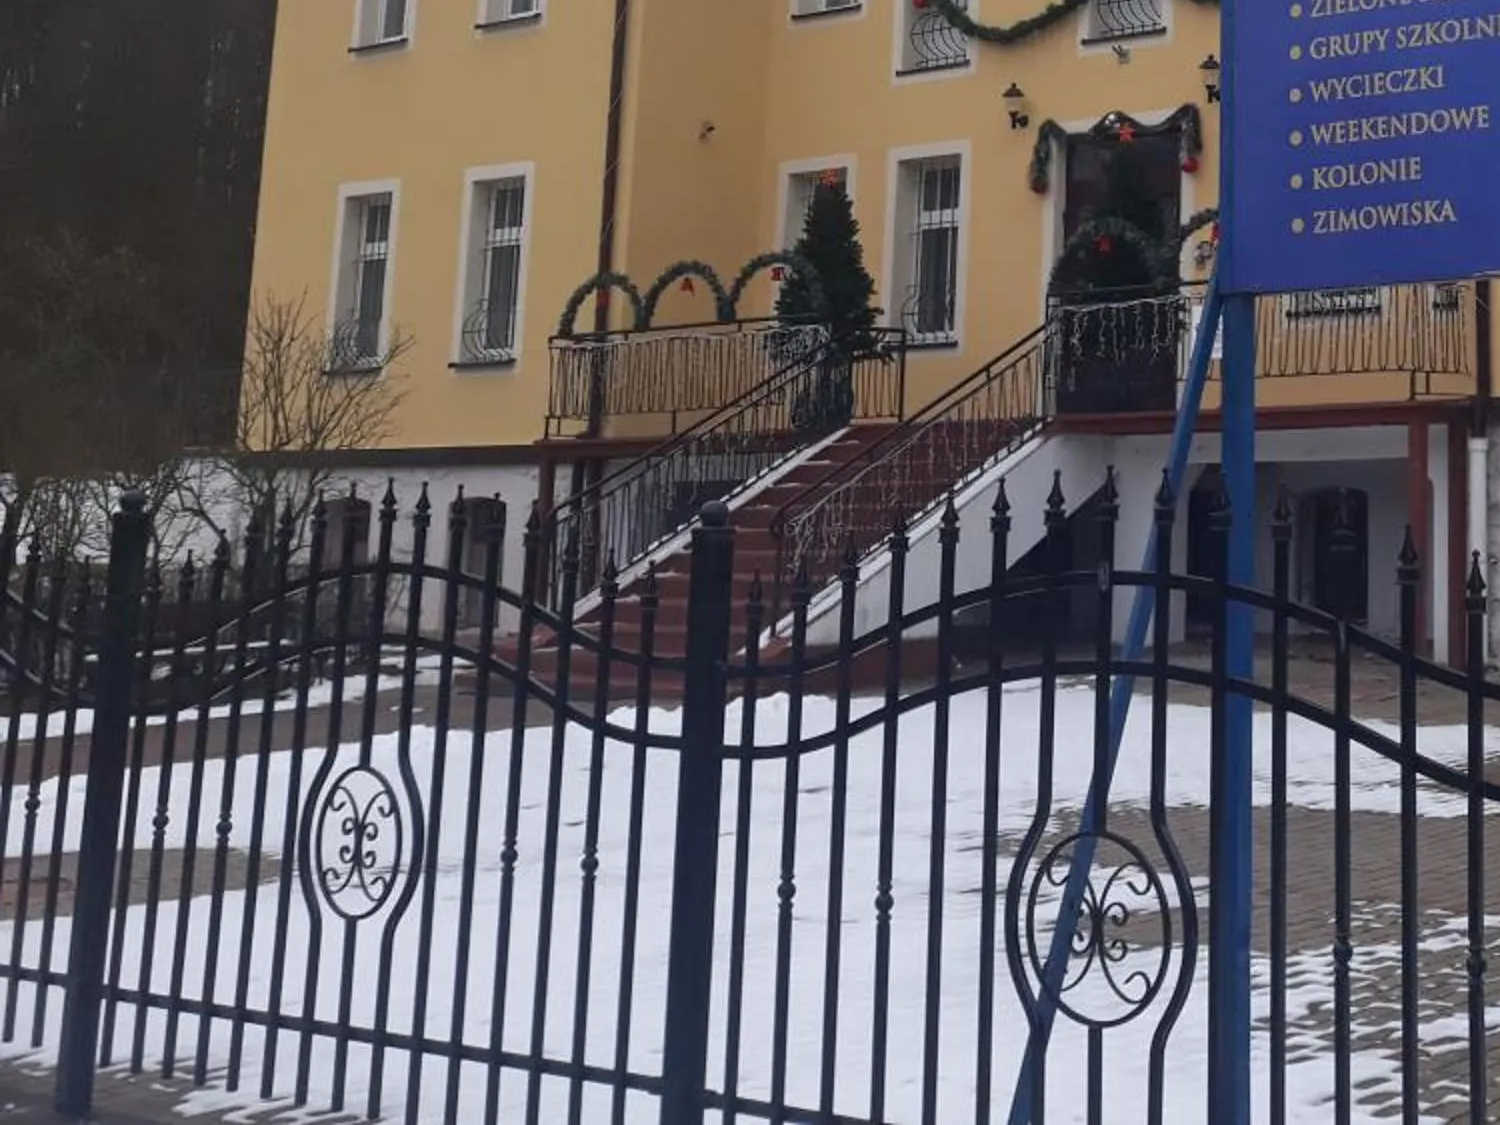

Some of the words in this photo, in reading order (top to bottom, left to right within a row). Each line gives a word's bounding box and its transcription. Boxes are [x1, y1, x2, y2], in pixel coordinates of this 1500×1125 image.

[1309, 28, 1390, 60] GRUPY
[1310, 66, 1446, 103] WYCIECZKI
[1311, 106, 1490, 146] WEEKENDOWE
[1312, 156, 1422, 190] KOLONIE
[1312, 198, 1457, 234] ZIMOWISKA
